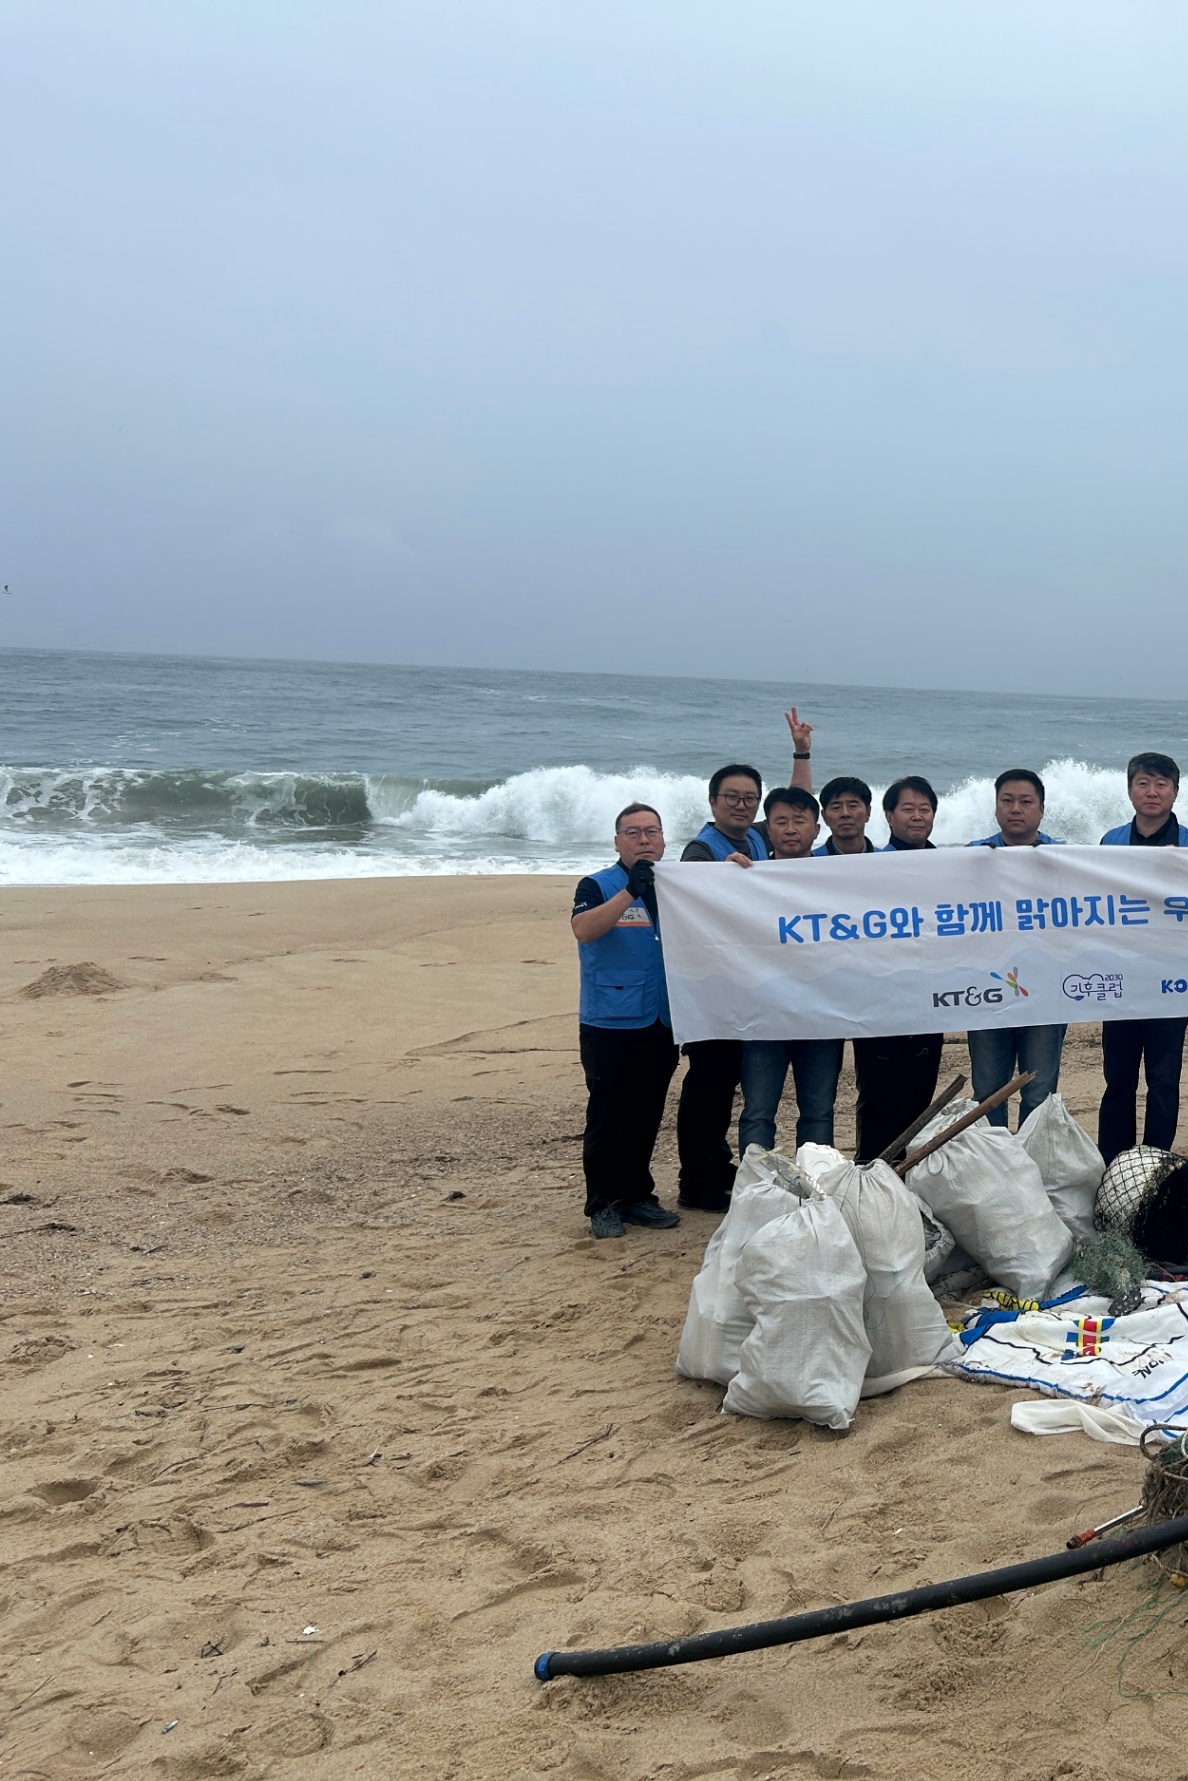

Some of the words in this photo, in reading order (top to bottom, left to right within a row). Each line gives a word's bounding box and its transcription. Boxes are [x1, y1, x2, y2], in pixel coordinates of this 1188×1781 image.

[778, 906, 924, 944] KT&G와
[935, 901, 1003, 937] 함께
[1015, 895, 1150, 931] 맑아지는
[1104, 973, 1124, 982] 2030
[932, 986, 1003, 1007] KT&G
[1070, 982, 1124, 1001] 기후클럽
